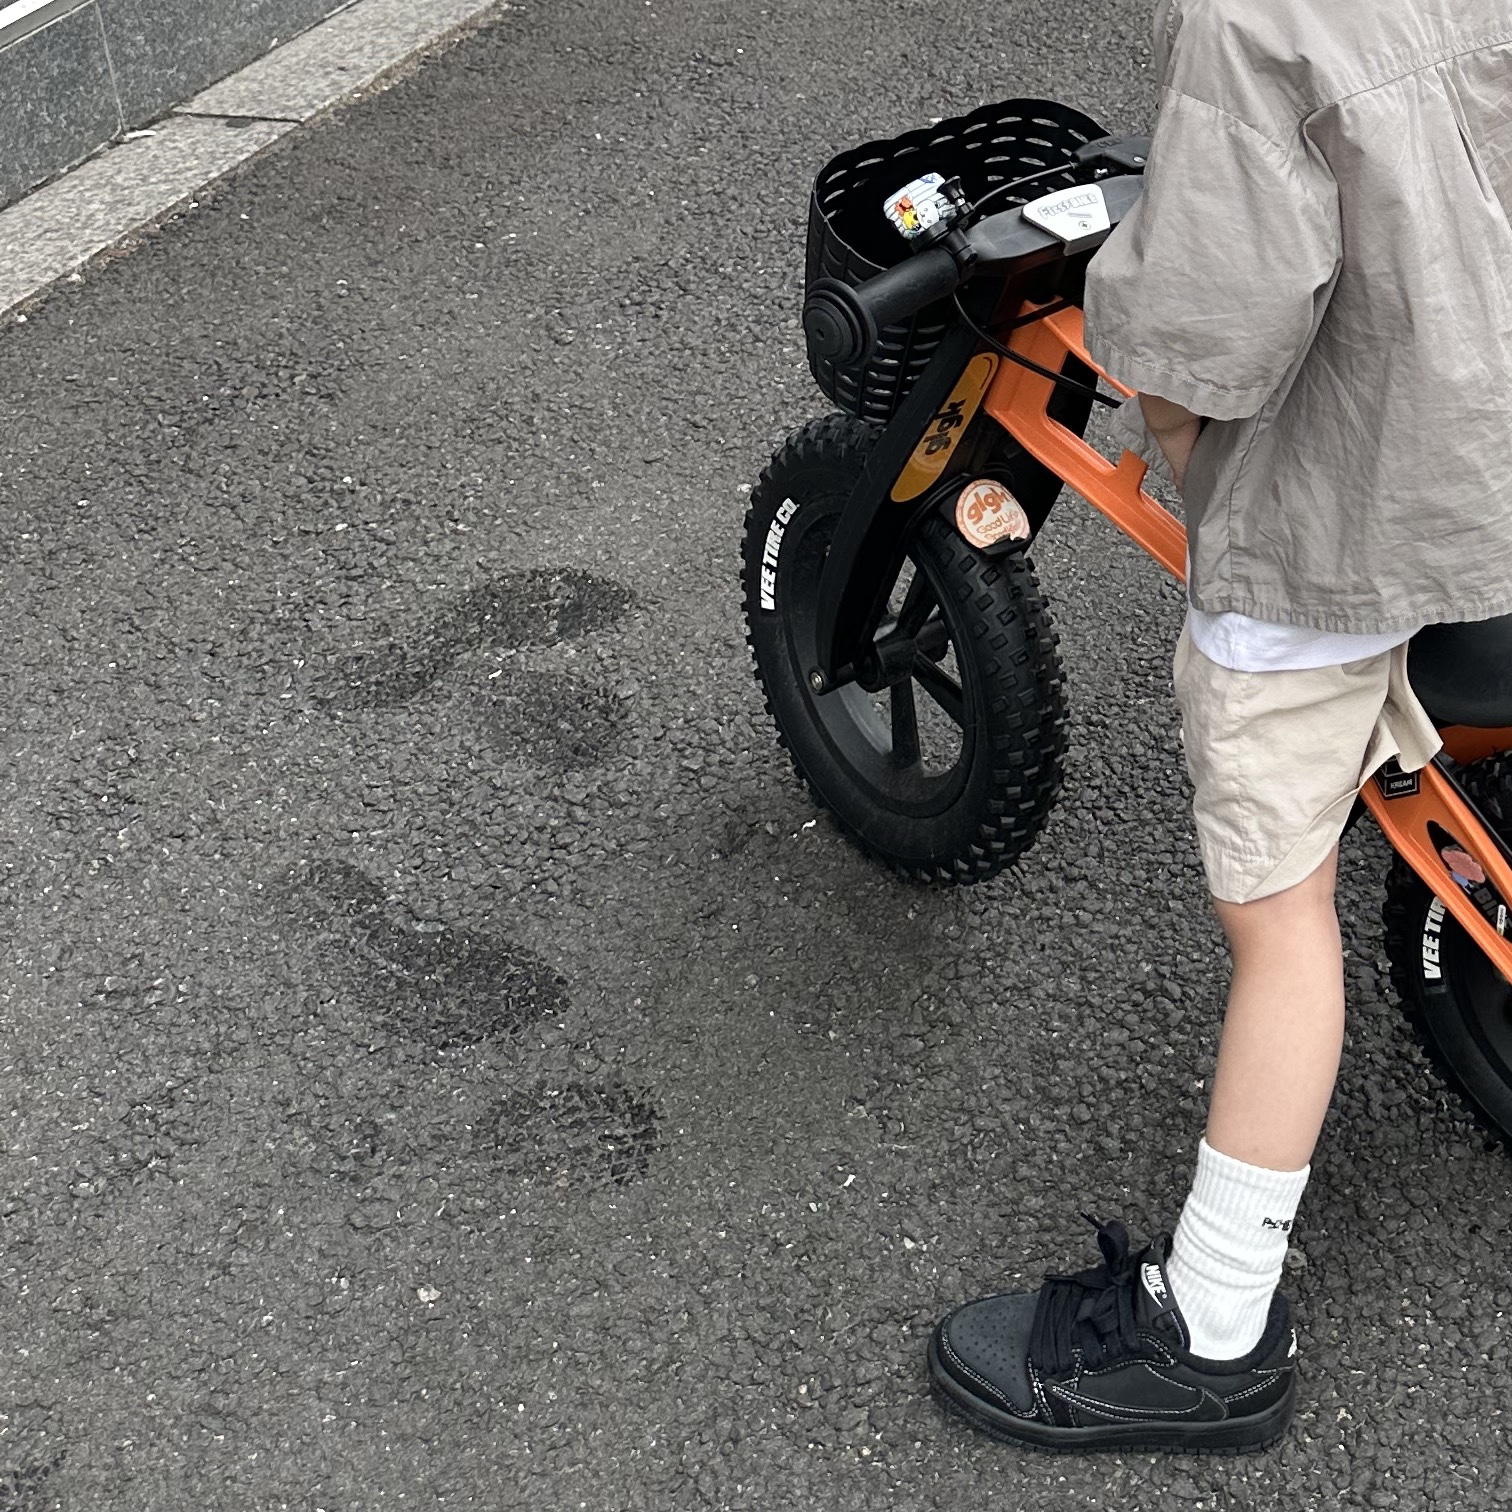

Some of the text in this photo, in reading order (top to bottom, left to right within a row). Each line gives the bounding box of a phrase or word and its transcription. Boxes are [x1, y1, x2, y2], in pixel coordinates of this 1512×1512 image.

[763, 519, 785, 567] TIRE
[761, 565, 776, 610] VEE
[1423, 933, 1441, 979] VEE
[1146, 1264, 1167, 1294] NIKE
